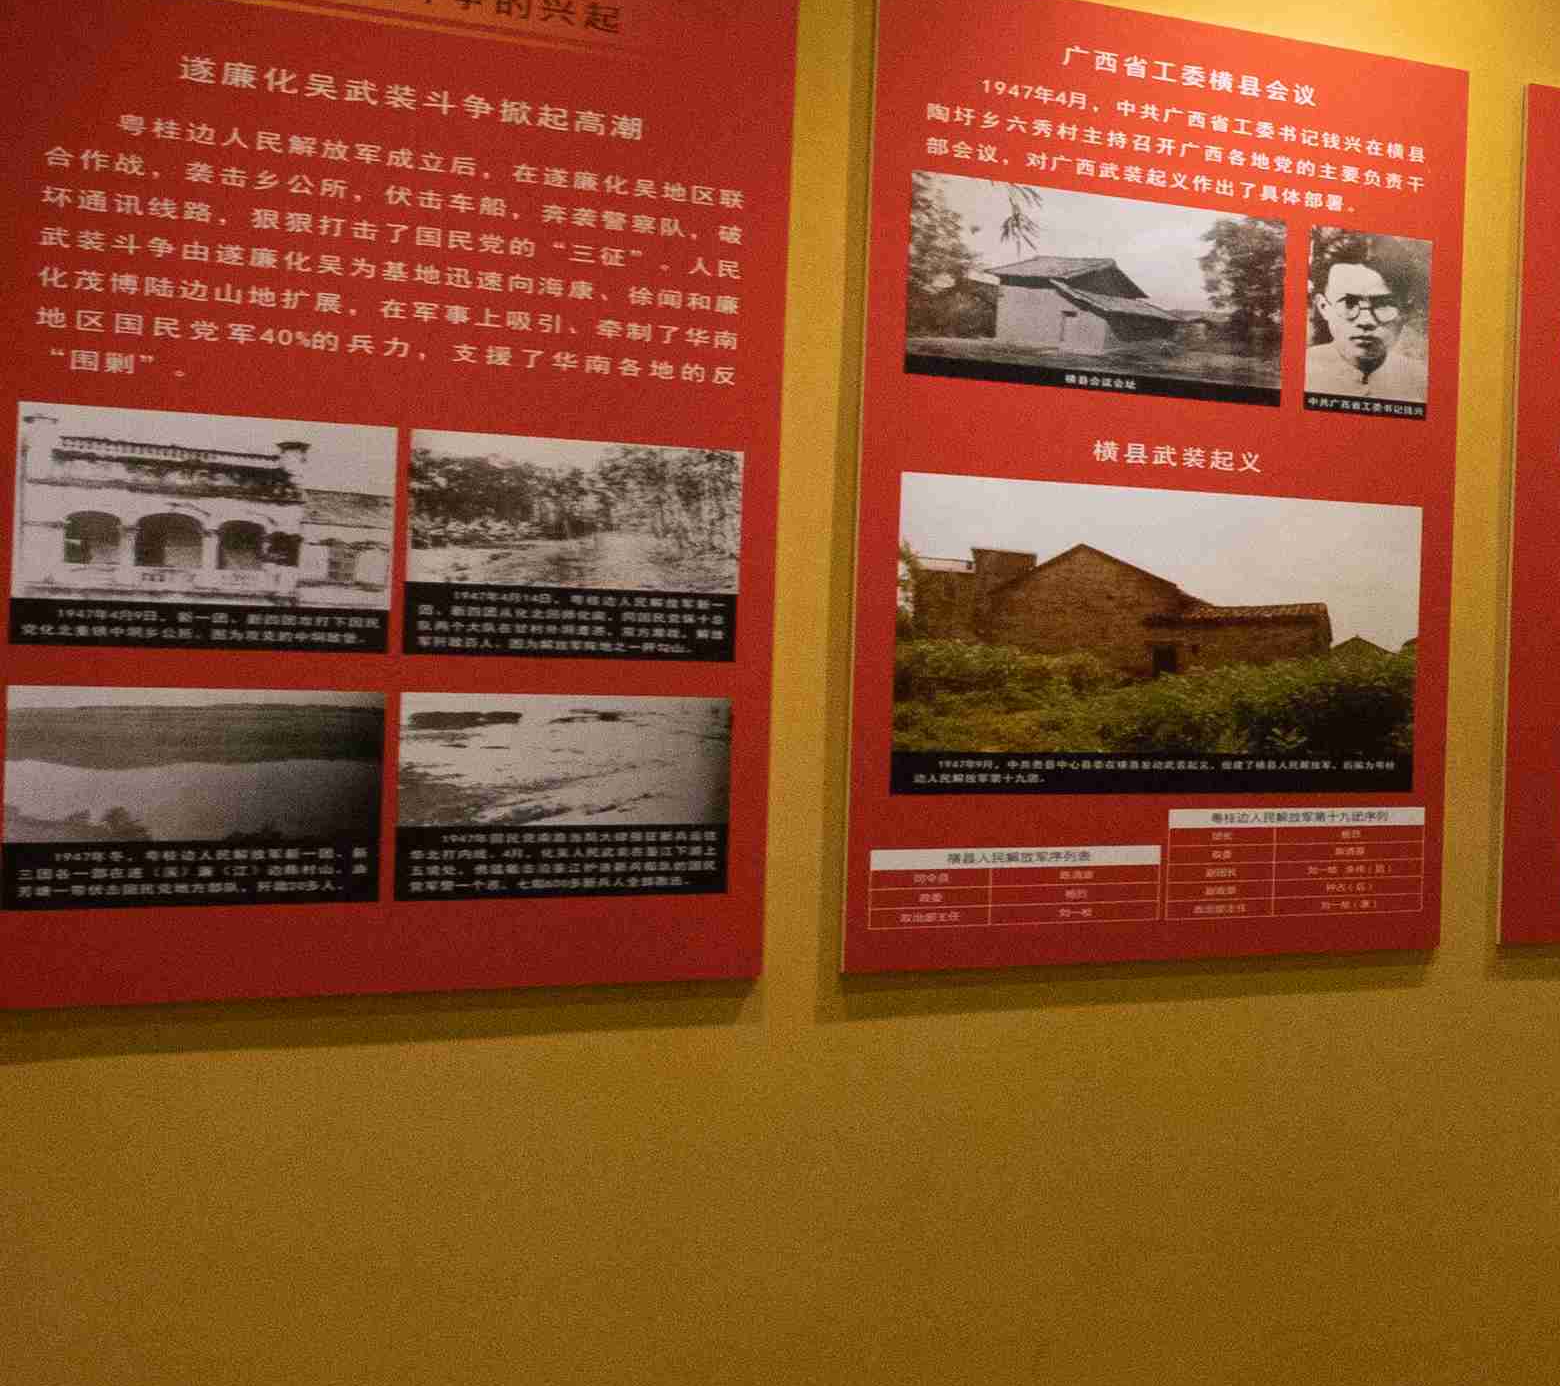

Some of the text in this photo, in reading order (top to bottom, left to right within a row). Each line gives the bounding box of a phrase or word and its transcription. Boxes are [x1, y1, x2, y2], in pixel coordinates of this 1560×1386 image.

[179, 55, 644, 142] 遂廉化吴武装斗争掀起高潮
[1062, 45, 1318, 106] 广西省工委横县会议
[982, 78, 1426, 163] 1947年4月，中共广西省工委书记钱兴在横县
[1092, 440, 1263, 472] 横县武装起义
